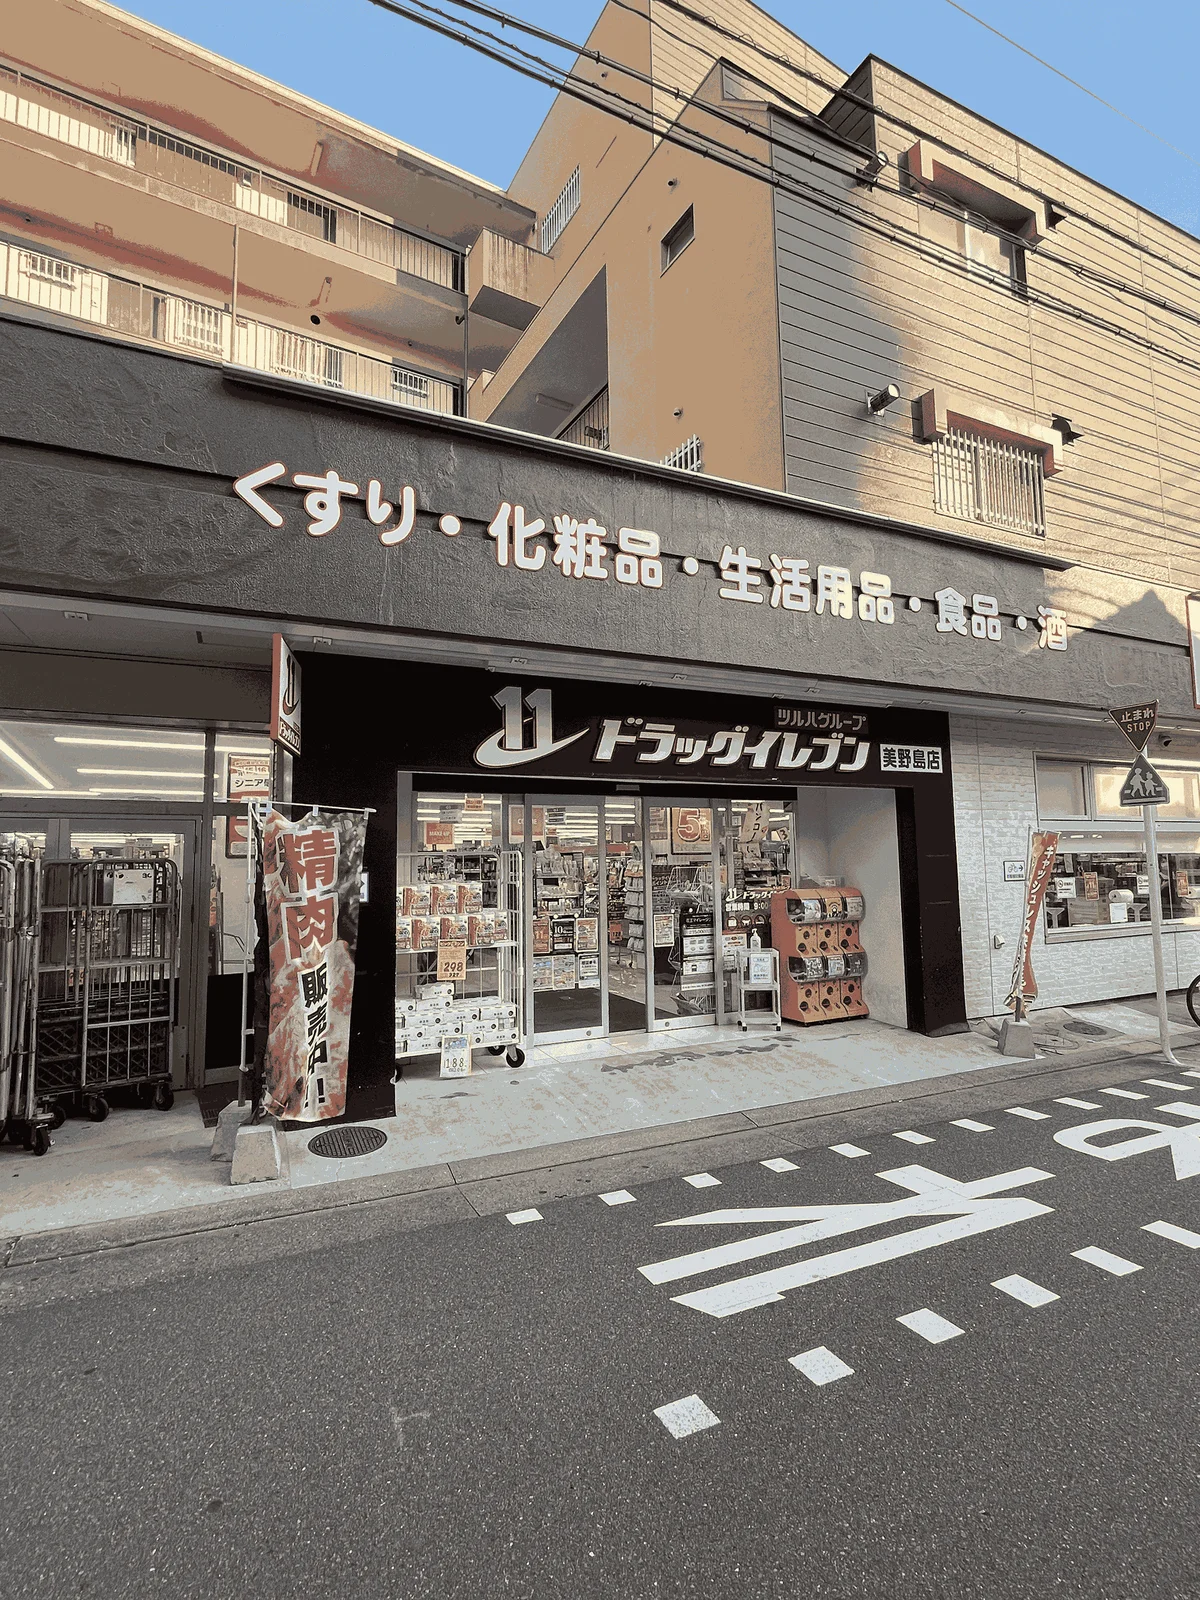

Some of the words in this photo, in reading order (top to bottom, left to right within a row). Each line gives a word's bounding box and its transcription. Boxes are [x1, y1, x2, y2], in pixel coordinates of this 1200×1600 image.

[776, 708, 867, 731] ツルハグループ
[1120, 708, 1154, 723] 止まれ
[1126, 721, 1151, 733] STOP
[593, 716, 871, 773] ドラッグイレブン
[881, 744, 943, 773] 美野島店
[444, 961, 463, 972] 298
